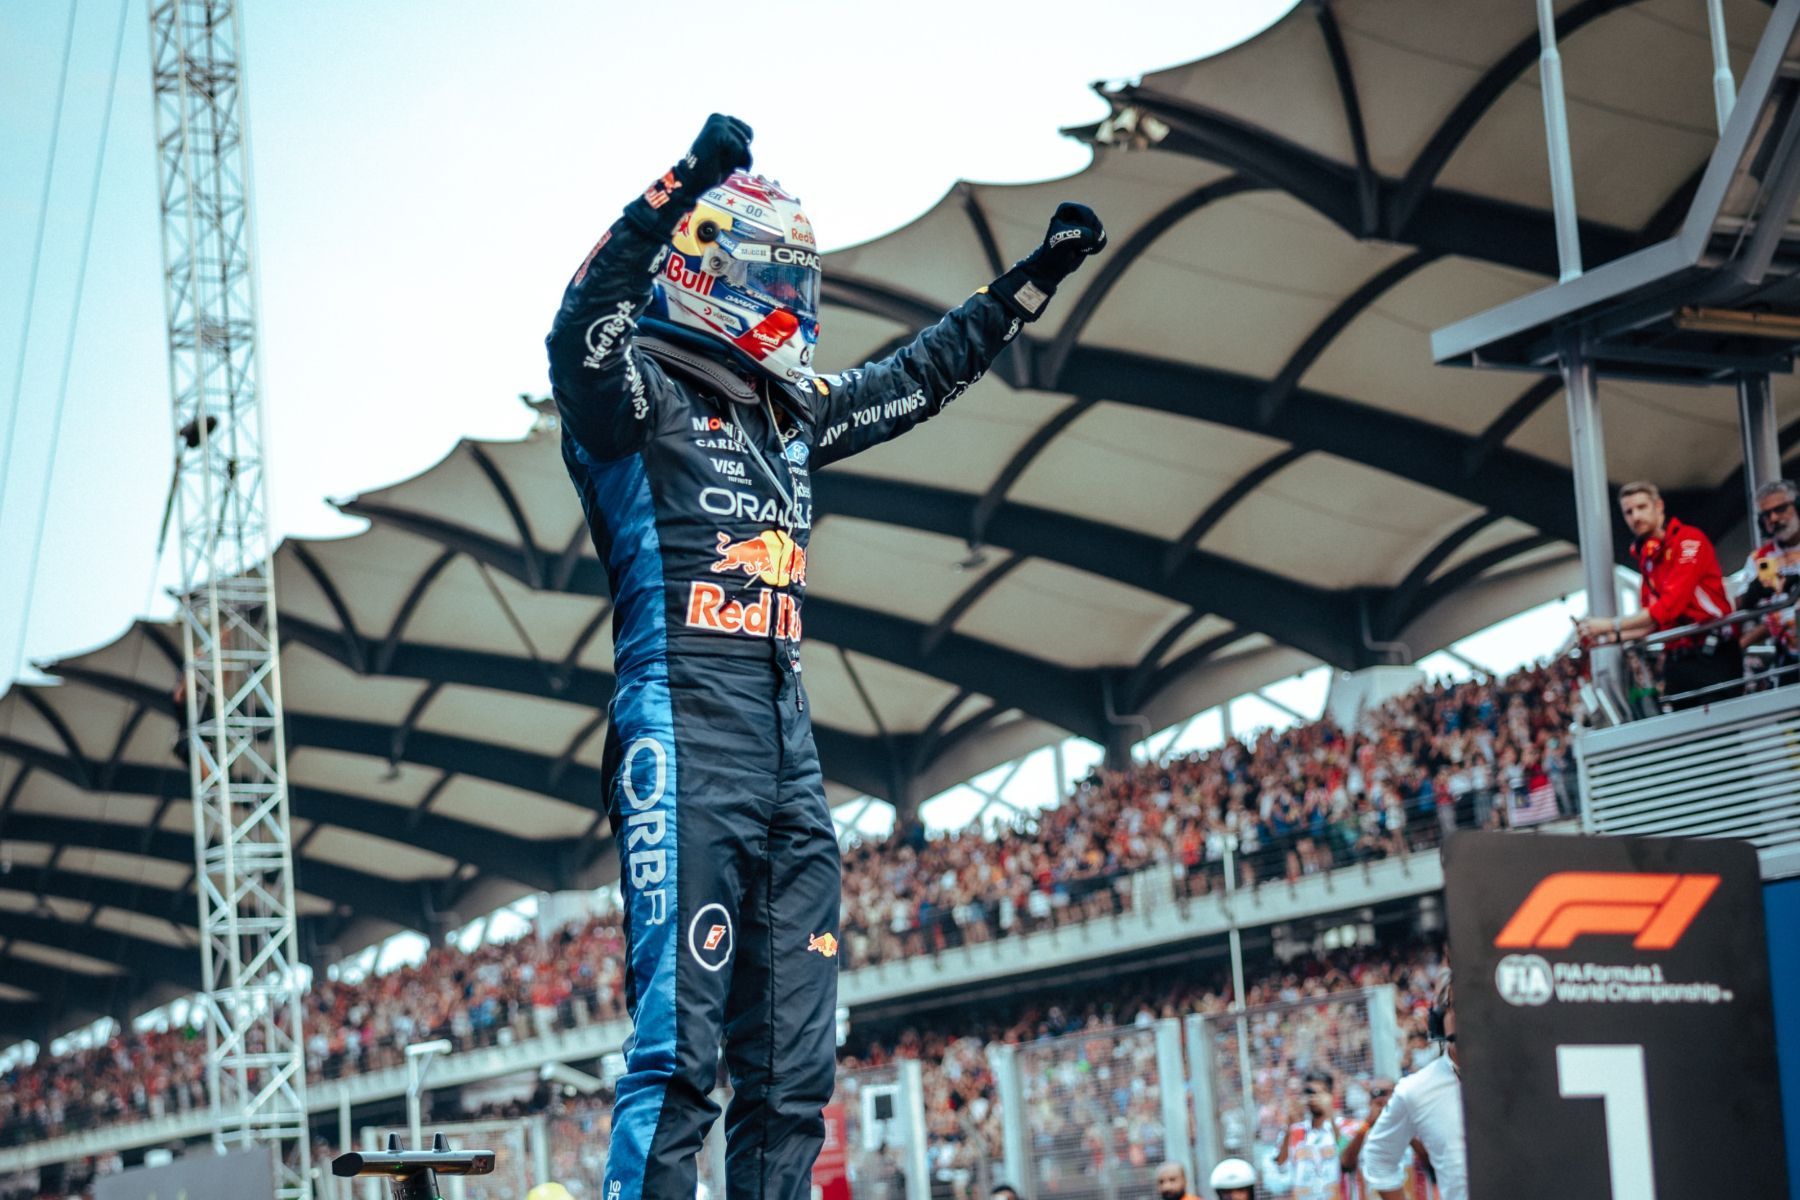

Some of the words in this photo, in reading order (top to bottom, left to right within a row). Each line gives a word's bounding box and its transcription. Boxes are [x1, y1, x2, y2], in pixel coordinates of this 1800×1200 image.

[666, 252, 717, 296] Bull
[774, 248, 821, 273] ORAC
[724, 294, 760, 311] DAMAC
[583, 332, 614, 369] Hard
[602, 300, 636, 337] Rock
[851, 405, 882, 427] YOU
[883, 387, 927, 419] WINGS
[709, 457, 746, 478] VISA
[686, 581, 773, 637] Red
[1499, 965, 1552, 996] FIA
[1583, 963, 1649, 983] Formula
[1651, 963, 1663, 983] 1
[1555, 982, 1605, 1002] World
[1607, 982, 1722, 1004] Championship
[1556, 1044, 1658, 1200] 1
